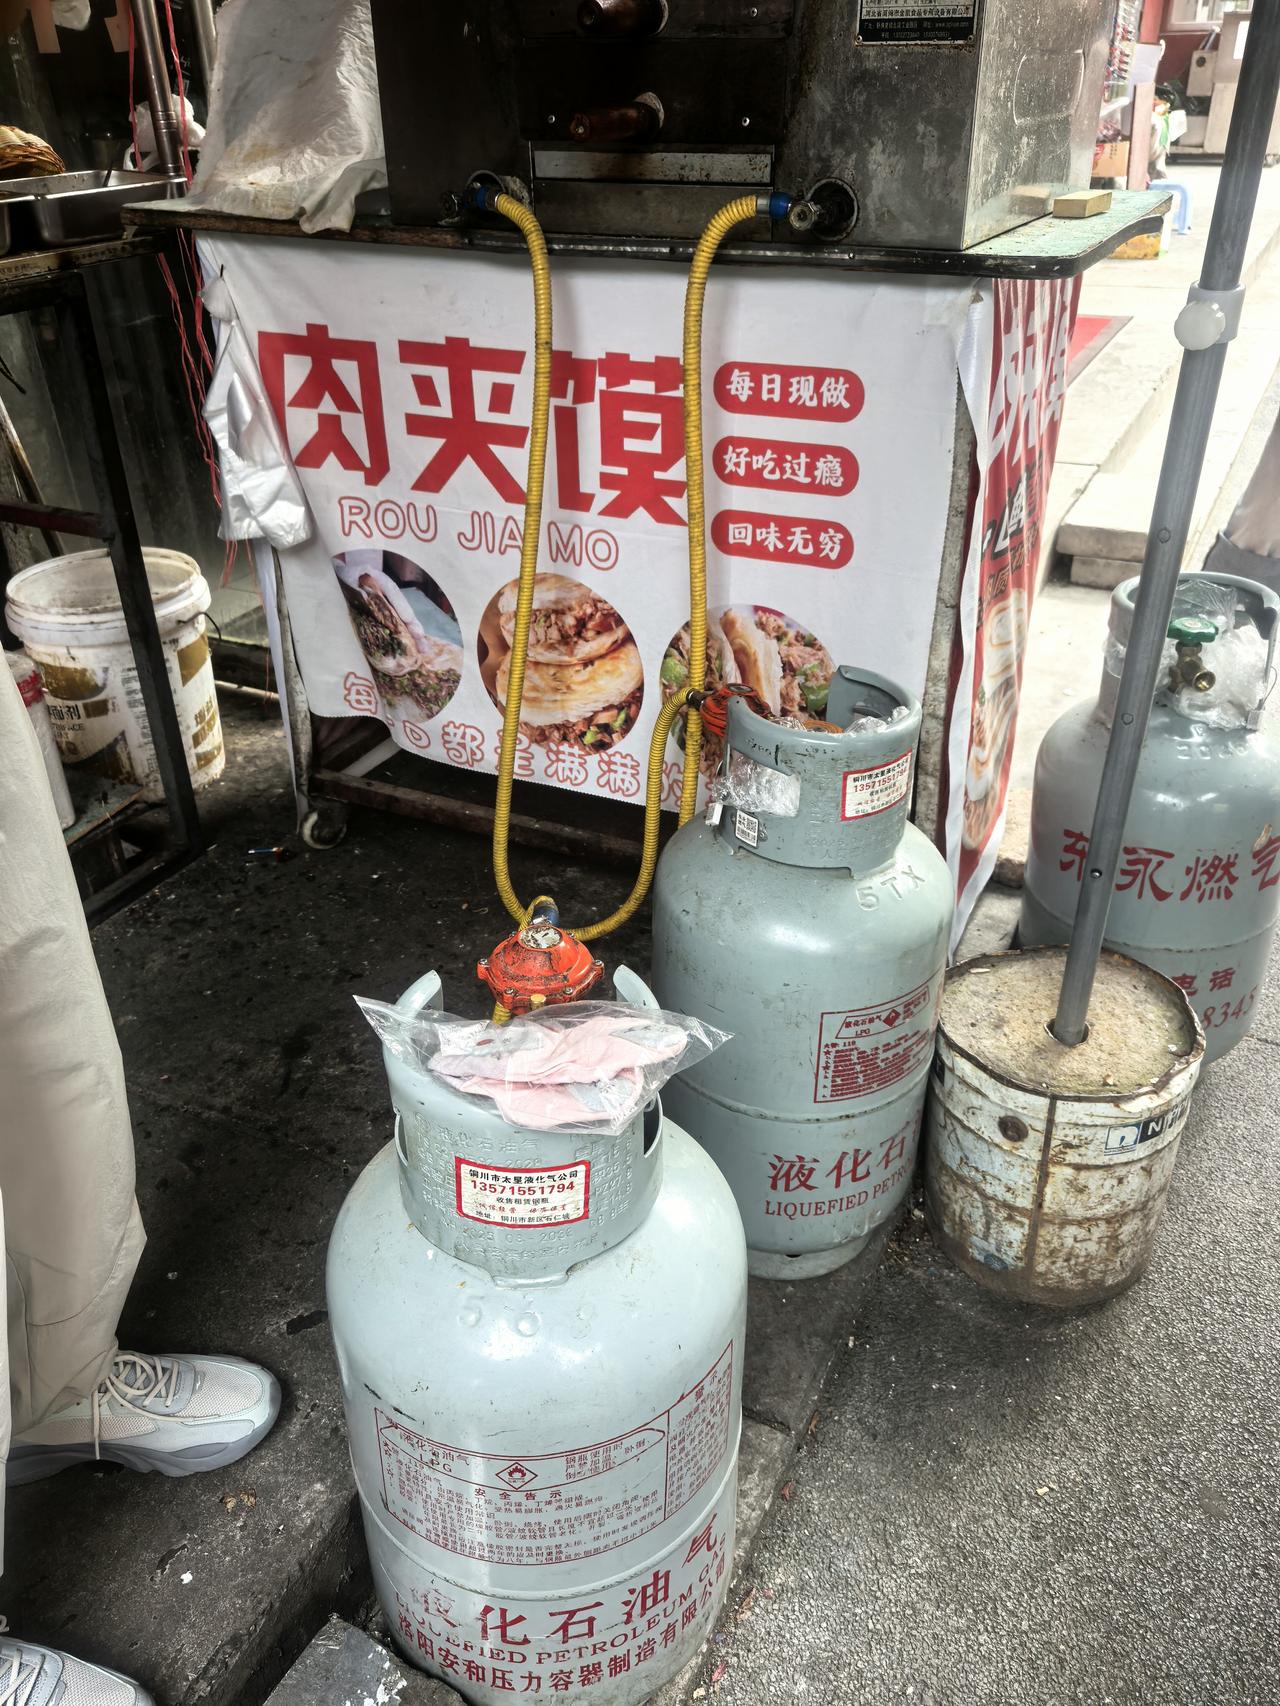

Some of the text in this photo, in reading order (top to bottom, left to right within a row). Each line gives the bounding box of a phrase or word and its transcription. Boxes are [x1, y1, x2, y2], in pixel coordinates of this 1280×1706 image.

[726, 368, 851, 409] 每日现做
[722, 445, 844, 487] 好吃过瘾
[339, 495, 619, 571] ROU JIA MO
[727, 521, 845, 561] 回味无穷
[1171, 968, 1236, 997] 电话
[470, 1180, 575, 1196] 13571551794
[765, 1190, 868, 1220] LIQUEFIED
[419, 1453, 452, 1473] LPG
[474, 1487, 562, 1502] 安全告示
[535, 1583, 693, 1665] PETROLEUM
